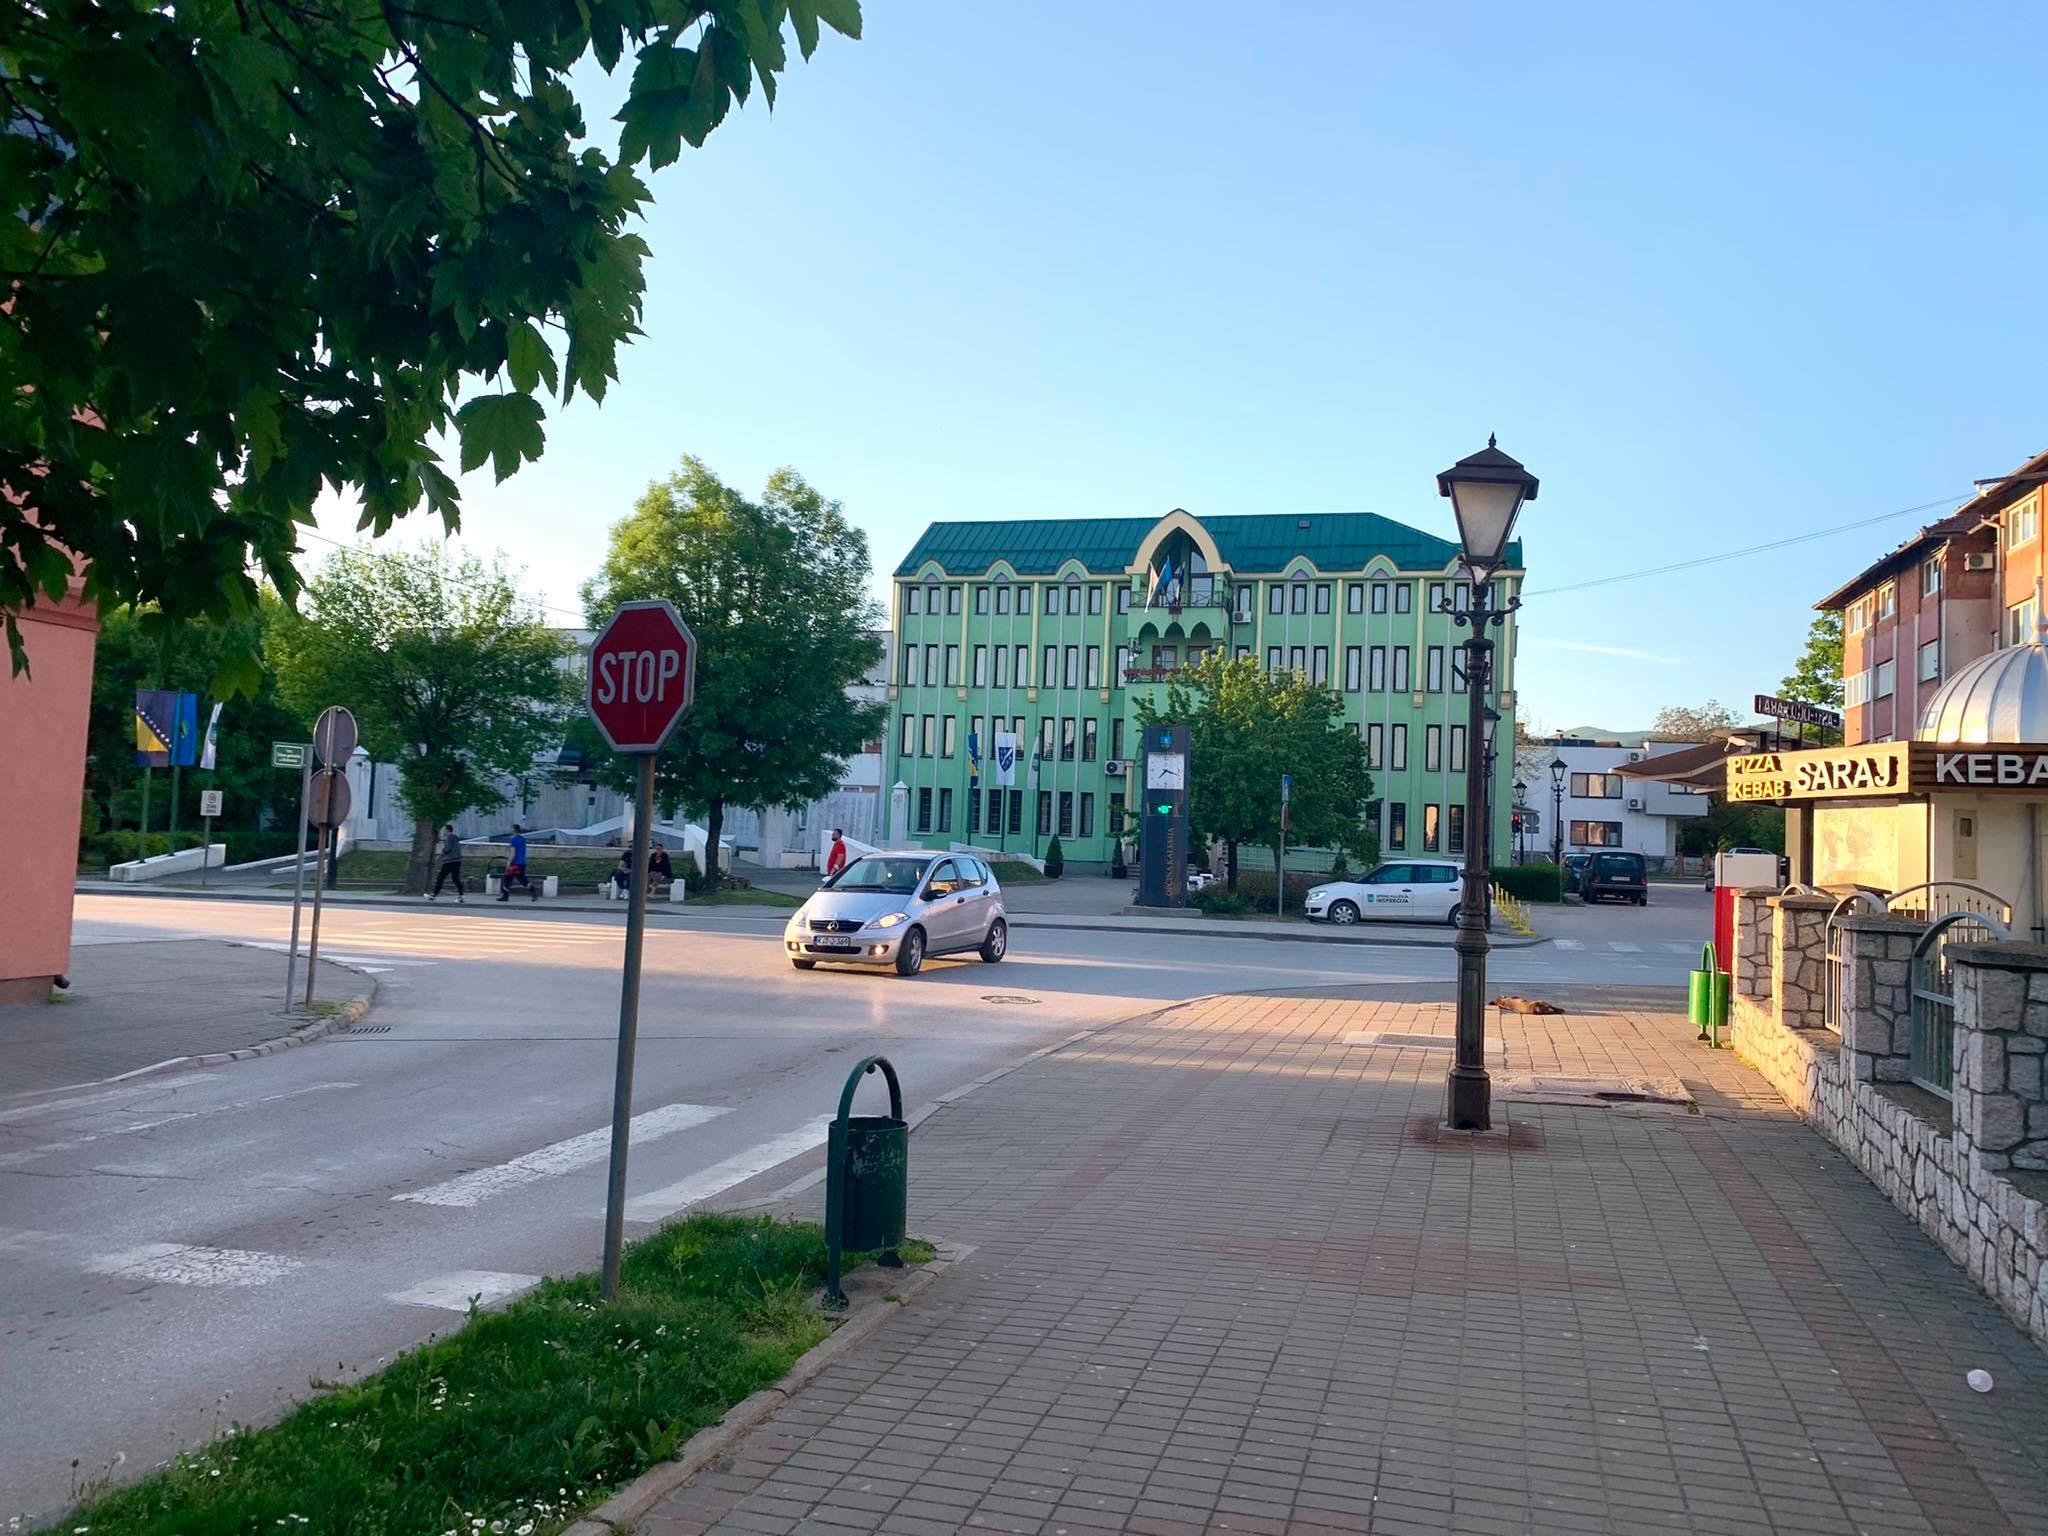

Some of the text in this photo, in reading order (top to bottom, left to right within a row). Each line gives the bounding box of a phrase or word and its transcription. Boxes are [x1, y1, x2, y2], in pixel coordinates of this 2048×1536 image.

[597, 649, 680, 705] STOP
[1732, 755, 1775, 774] PIZZA
[1793, 756, 1891, 792] SARAJ
[1936, 753, 2048, 785] KEBA
[1731, 780, 1785, 799] KEBAB
